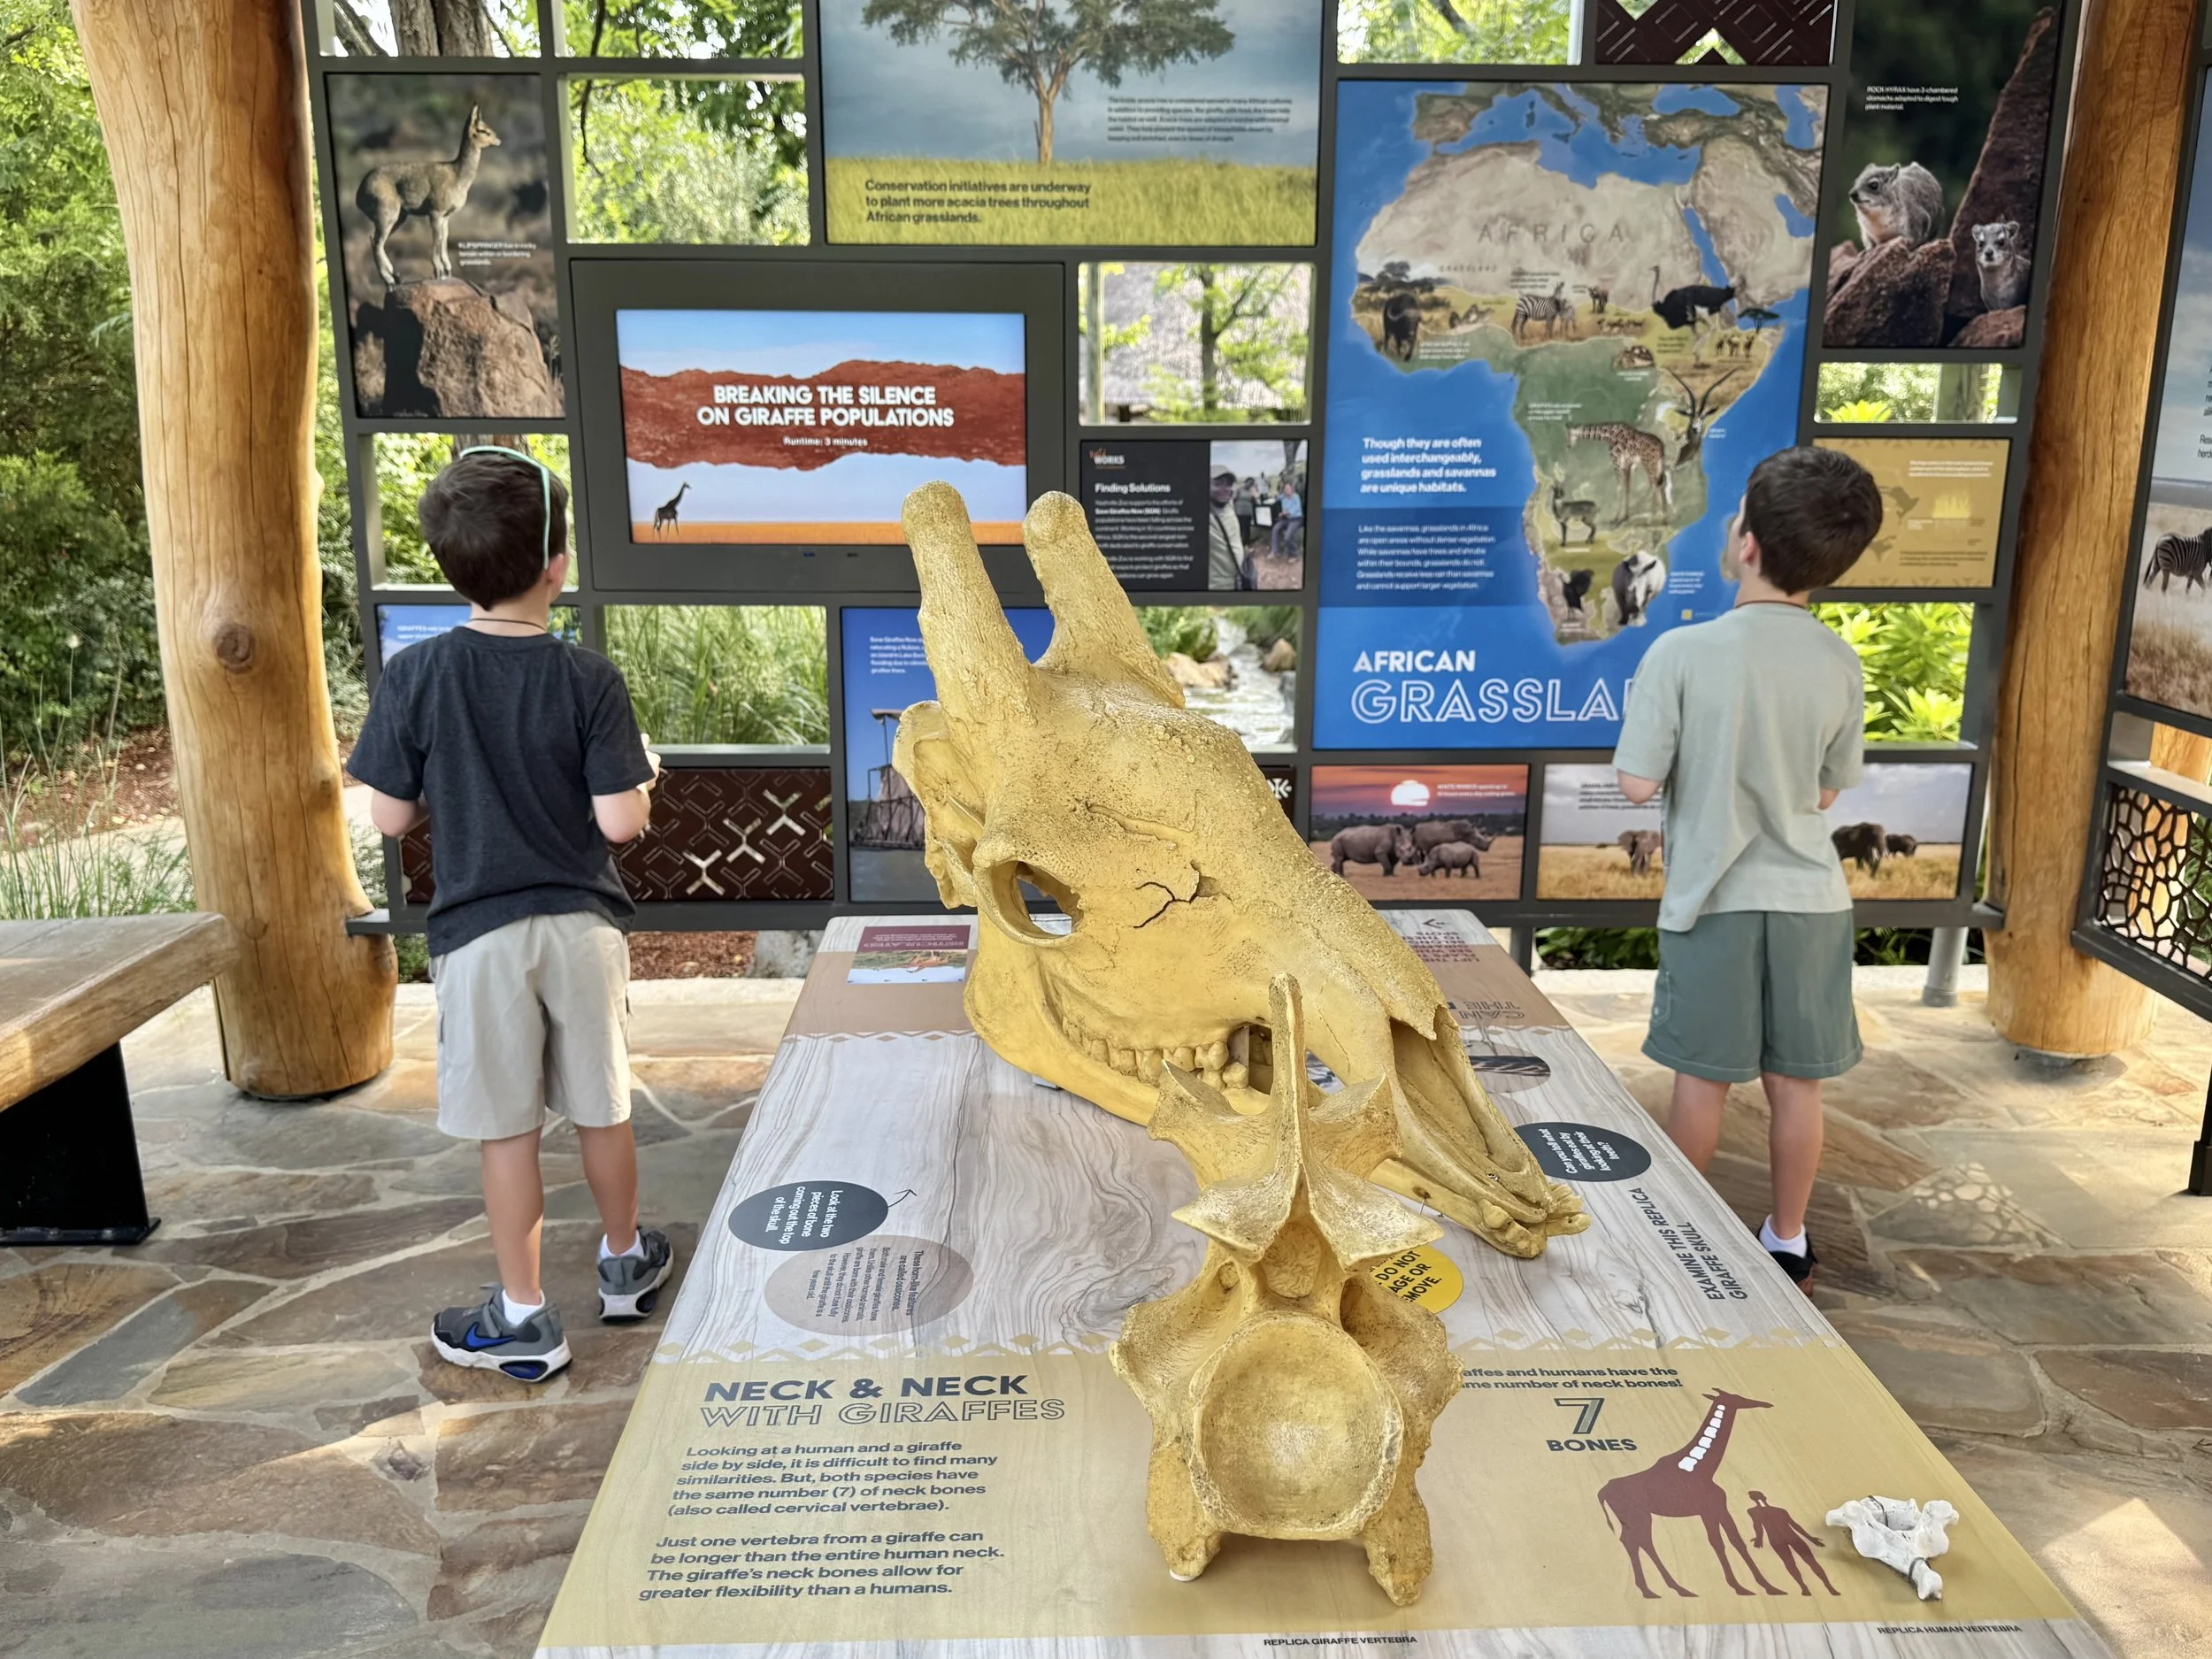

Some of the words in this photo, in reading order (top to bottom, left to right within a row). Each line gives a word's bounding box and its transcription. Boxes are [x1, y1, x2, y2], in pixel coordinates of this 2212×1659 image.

[865, 180, 947, 191] Conservation
[949, 180, 1007, 192] initiatives
[1009, 183, 1028, 192] are
[1031, 181, 1091, 194] underway
[866, 196, 878, 207] to
[880, 196, 910, 209] plant
[913, 199, 944, 208] more
[947, 197, 986, 208] acacia
[988, 197, 1019, 208] trees
[1022, 196, 1090, 210] throughout
[867, 211, 910, 222] African
[912, 211, 981, 224] grasslands.
[713, 384, 812, 404] BREAKING
[818, 385, 855, 405] THE
[858, 385, 936, 406] SILENCE
[696, 407, 729, 426] ON
[734, 407, 816, 426] GIRAFFE
[820, 408, 955, 427] POPULATIONS
[783, 436, 823, 447] Runtime:
[825, 436, 831, 447] 3
[833, 437, 868, 448] minutes
[1363, 437, 1405, 451] Though
[1406, 437, 1431, 451] they
[1432, 439, 1451, 449] are
[1452, 437, 1482, 449] often
[1362, 452, 1389, 464] used
[1390, 452, 1482, 465] interchangeably,
[1361, 467, 1420, 481] grasslands
[1422, 467, 1443, 478] and
[1444, 468, 1497, 478] savannas
[1094, 483, 1129, 495] Finding
[1129, 483, 1171, 493] Solutions
[1360, 483, 1379, 493] are
[1379, 483, 1417, 495] unique
[1418, 482, 1467, 493] habitats.
[1353, 650, 1476, 672] AFRICAN
[1351, 678, 1636, 724] GRASSLA
[1538, 1129, 1555, 1142] what
[1562, 1139, 1577, 1148] eat
[1574, 1131, 1592, 1144] their
[1547, 1141, 1562, 1151] tell
[1597, 1141, 1620, 1160] teeth?
[1555, 1150, 1572, 1162] you
[1571, 1148, 1595, 1170] giraffes
[1588, 1149, 1611, 1171] looking
[1563, 1162, 1578, 1173] Can
[788, 1186, 806, 1209] coming
[809, 1191, 824, 1212] pieces
[829, 1190, 843, 1206] Look
[772, 1204, 786, 1215] the
[1629, 1187, 1669, 1226] REPLICA
[788, 1210, 799, 1221] out
[824, 1213, 837, 1225] the
[765, 1215, 781, 1233] skull.
[785, 1220, 798, 1233] the
[802, 1219, 818, 1237] bone
[820, 1225, 834, 1238] two
[779, 1233, 795, 1244] top
[1658, 1229, 1686, 1250] THIS
[1678, 1222, 1711, 1252] SKULL
[913, 1250, 924, 1267] These
[1375, 1267, 1398, 1281] DO
[1394, 1250, 1421, 1268] NOT
[896, 1264, 907, 1281] called
[910, 1267, 922, 1291] horn-like
[1388, 1275, 1416, 1293] AGE
[1409, 1263, 1432, 1276] OR
[1676, 1253, 1724, 1300] EXAMINE
[1701, 1255, 1747, 1300] GIRAFFE
[1402, 1277, 1442, 1302] MOVE.
[906, 1292, 918, 1316] features
[1463, 1368, 1503, 1378] affes
[1507, 1368, 1537, 1377] and
[1540, 1368, 1606, 1377] humans
[1608, 1367, 1648, 1376] have
[705, 1379, 836, 1402] NECK
[849, 1378, 882, 1399] &
[900, 1374, 1028, 1397] NECK
[1494, 1379, 1558, 1388] number
[1562, 1379, 1578, 1388] of
[1581, 1379, 1623, 1388] neck
[1627, 1378, 1683, 1387] bones!
[701, 1404, 822, 1427] WITH
[839, 1398, 1065, 1425] GIRAFFES
[1554, 1398, 1605, 1434] 7
[687, 1446, 758, 1457] Looking
[761, 1446, 778, 1455] at
[795, 1445, 854, 1454] human
[857, 1443, 890, 1453] and
[906, 1441, 962, 1453] giraffe
[1546, 1439, 1637, 1451] BONES
[681, 1460, 718, 1471] side
[722, 1461, 743, 1471] by
[746, 1459, 787, 1471] side,
[790, 1459, 803, 1469] it
[805, 1458, 820, 1468] is
[823, 1457, 889, 1467] difficult
[892, 1457, 910, 1466] to
[913, 1455, 947, 1465] find
[949, 1456, 998, 1466] many
[677, 1475, 777, 1485] similarities.
[780, 1473, 816, 1485] But,
[819, 1472, 861, 1482] both
[864, 1471, 933, 1483] species
[936, 1470, 979, 1480] have
[672, 1490, 702, 1500] the
[704, 1490, 754, 1499] same
[757, 1488, 828, 1498] number
[833, 1486, 856, 1498] (7)
[860, 1486, 879, 1496] of
[882, 1486, 926, 1495] neck
[930, 1485, 986, 1494] bones
[668, 1504, 712, 1517] (also
[716, 1503, 772, 1515] called
[774, 1502, 846, 1514] cervical
[850, 1500, 949, 1511] vertebrae).
[657, 1537, 697, 1547] Just
[700, 1538, 736, 1547] one
[741, 1534, 819, 1546] vertebra
[824, 1533, 867, 1544] from
[886, 1532, 945, 1545] giraffe
[949, 1532, 983, 1541] can
[650, 1553, 675, 1563] be
[679, 1553, 741, 1565] longer
[744, 1551, 787, 1562] than
[791, 1550, 821, 1562] the
[826, 1549, 880, 1560] entire
[885, 1548, 949, 1560] human
[953, 1547, 1004, 1557] neck.
[647, 1570, 683, 1581] The
[687, 1568, 762, 1582] giraffe’s
[766, 1568, 814, 1579] neck
[818, 1567, 878, 1578] bones
[882, 1565, 933, 1577] allow
[936, 1564, 964, 1576] for
[639, 1587, 712, 1601] greater
[716, 1585, 803, 1598] flexibility
[807, 1584, 850, 1595] than
[871, 1583, 952, 1594] humans.
